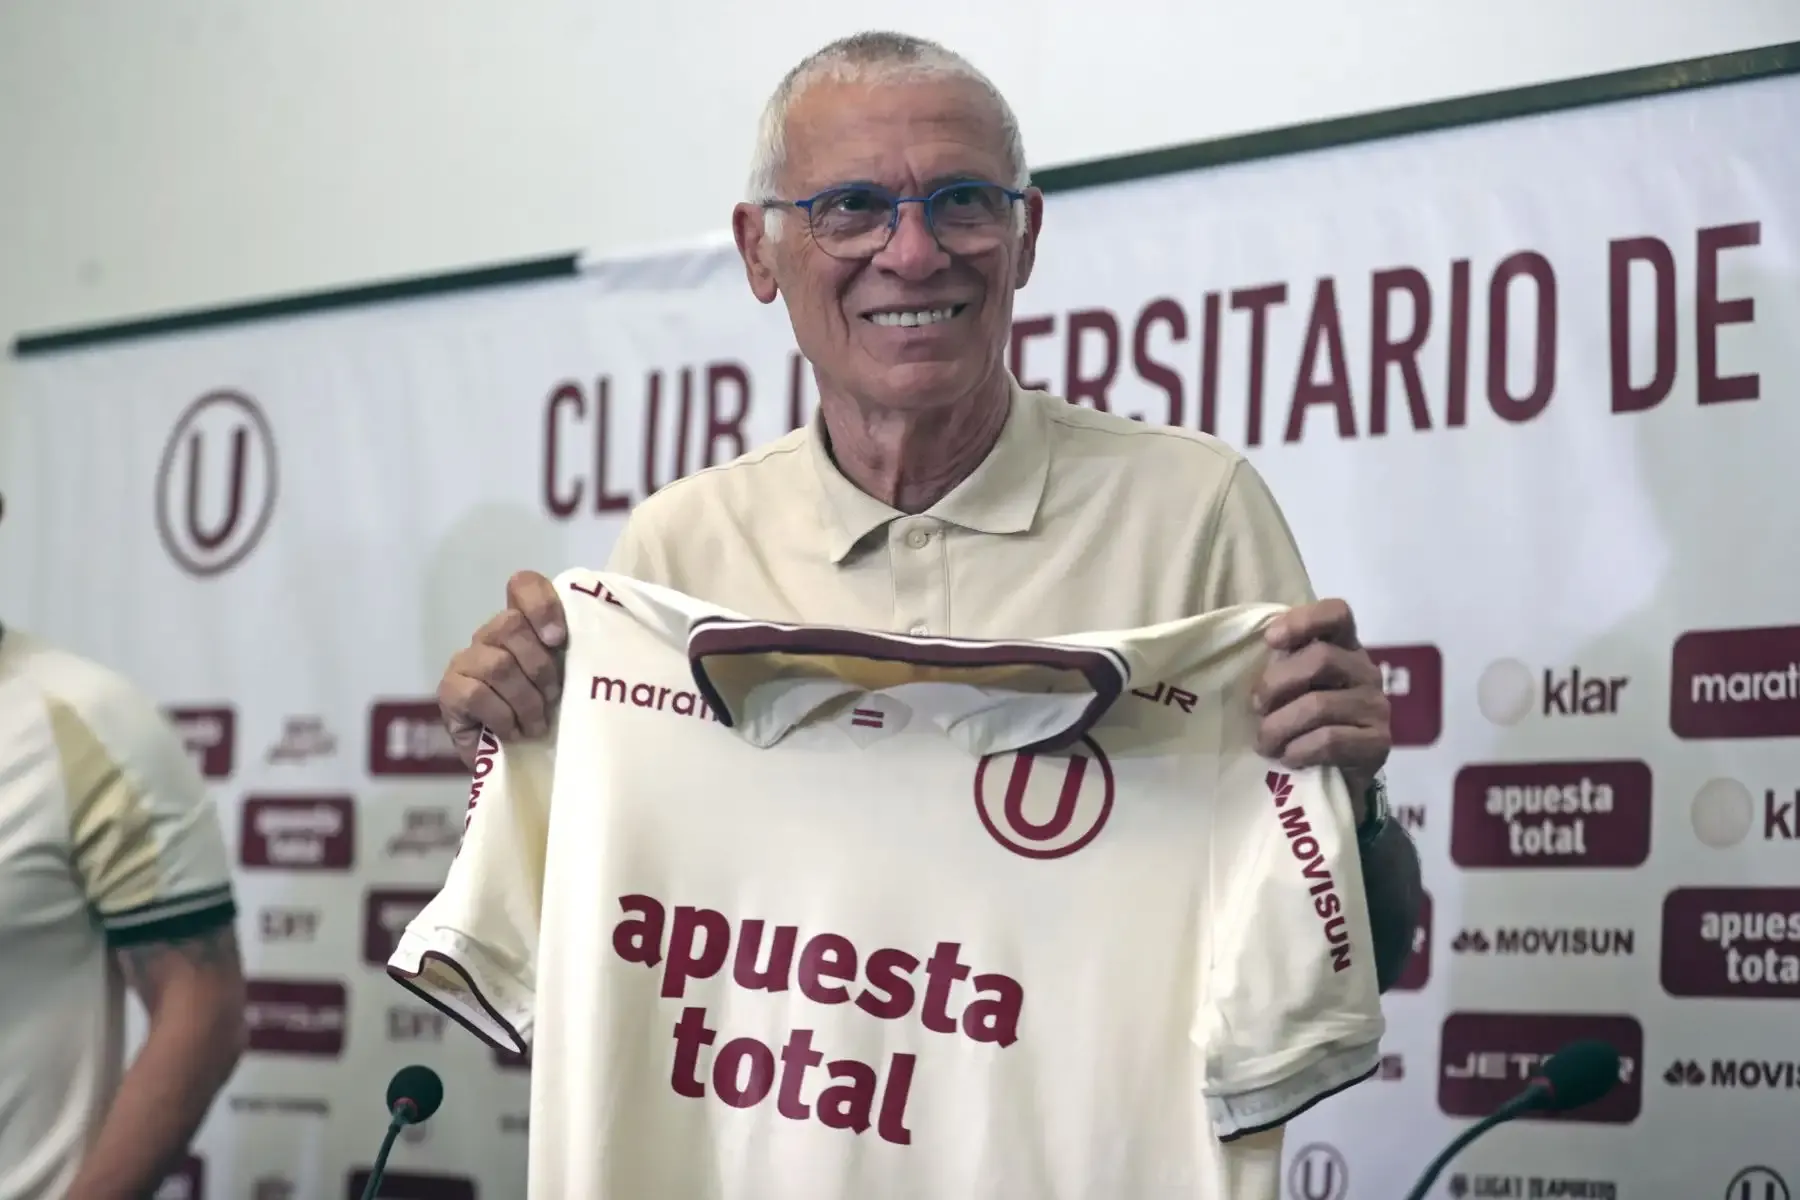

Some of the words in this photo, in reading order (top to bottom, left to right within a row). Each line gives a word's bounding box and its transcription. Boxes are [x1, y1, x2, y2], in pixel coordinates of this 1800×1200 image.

[543, 362, 752, 517] CLUB
[790, 249, 1558, 448] ERSITARIO
[1609, 222, 1761, 415] DE
[1543, 666, 1628, 716] klar
[1691, 662, 1800, 702] marat
[1004, 752, 1089, 841] U
[1486, 779, 1613, 820] apuesta
[1509, 818, 1586, 855] total
[1279, 806, 1352, 972] MOVISUN
[1496, 928, 1634, 955] MOVISUN
[1726, 948, 1800, 984] tota
[612, 893, 1024, 1048] apuesta
[670, 1006, 916, 1145] total
